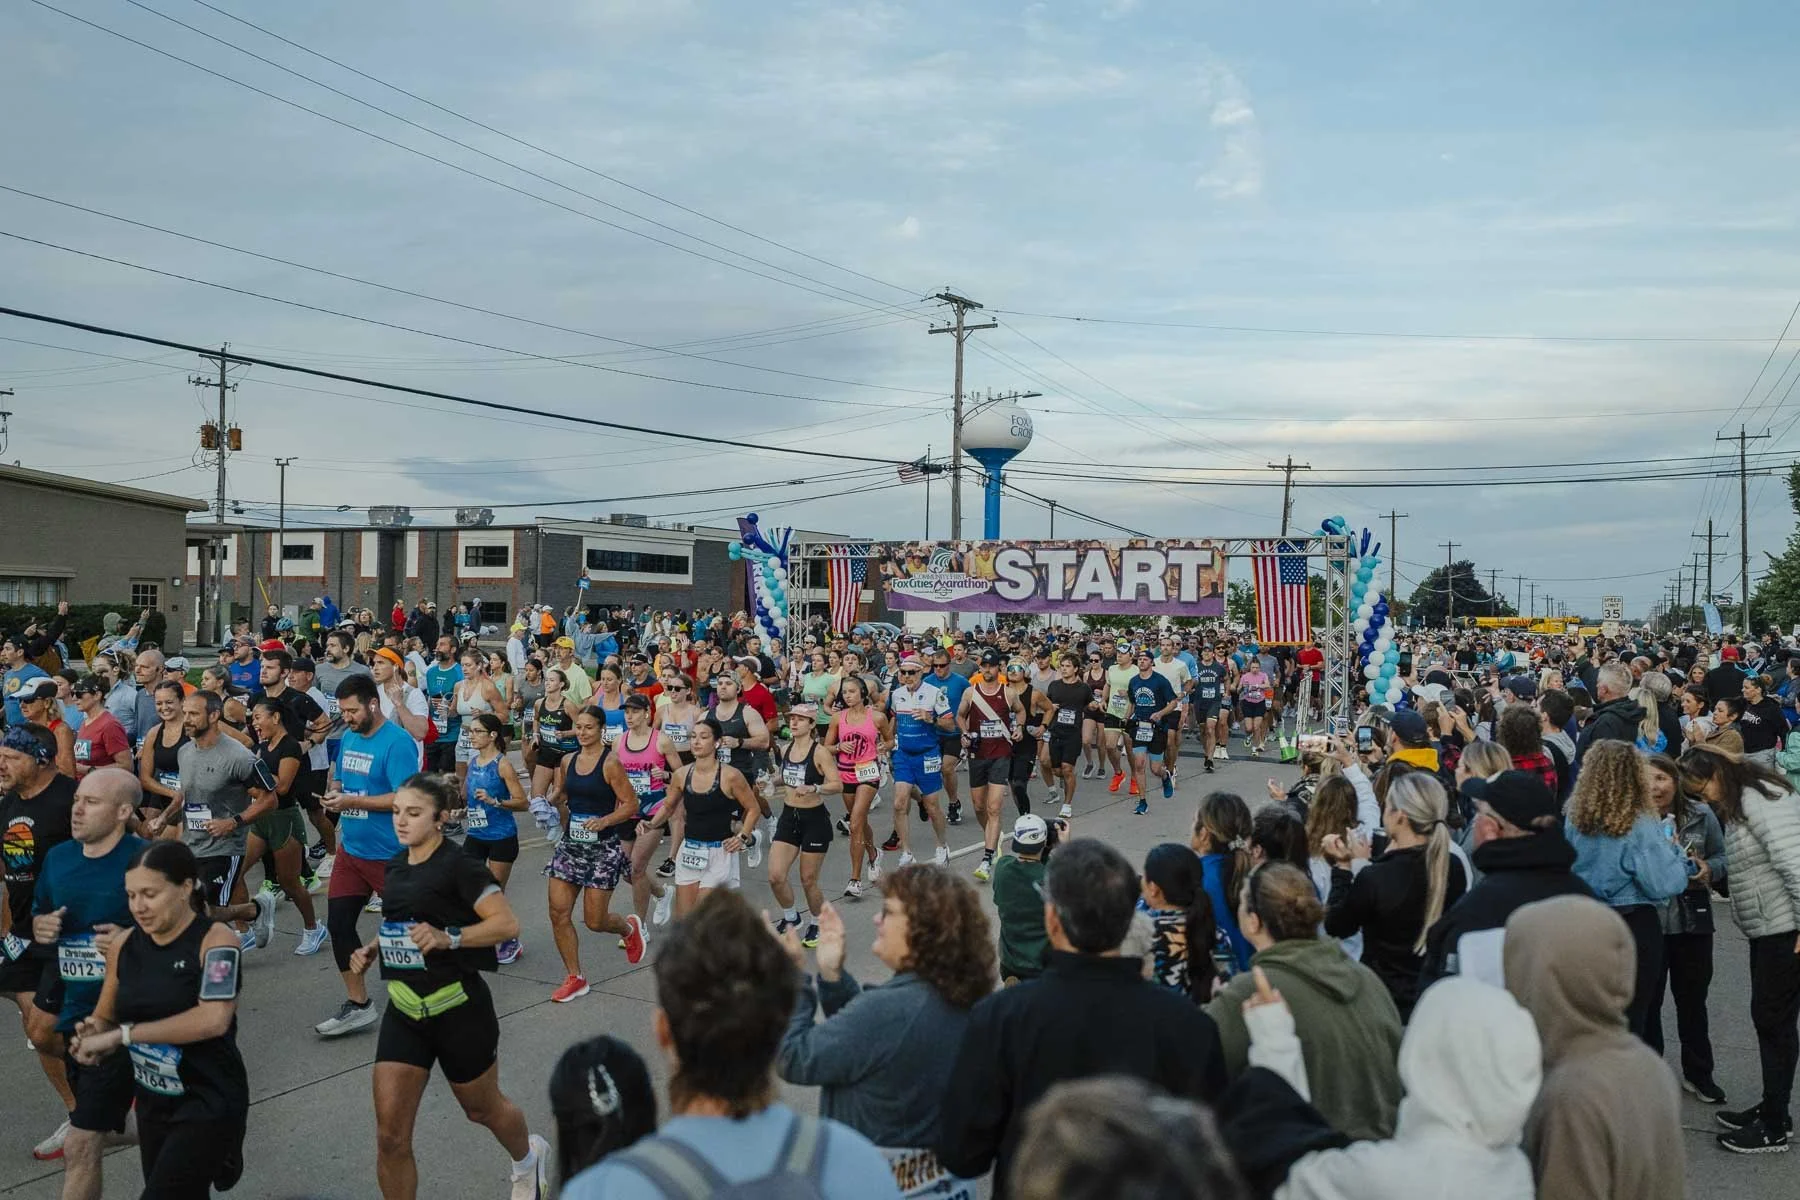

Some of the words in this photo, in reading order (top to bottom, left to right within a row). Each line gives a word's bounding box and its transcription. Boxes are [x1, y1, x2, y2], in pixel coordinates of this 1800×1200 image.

[1011, 414, 1029, 427] FOX
[995, 548, 1212, 602] START
[934, 578, 988, 590] Marathon
[1604, 609, 1620, 619] 35
[571, 830, 590, 840] 4285
[384, 949, 412, 964] 4106
[62, 961, 96, 977] 4012
[134, 1063, 168, 1090] 3164
